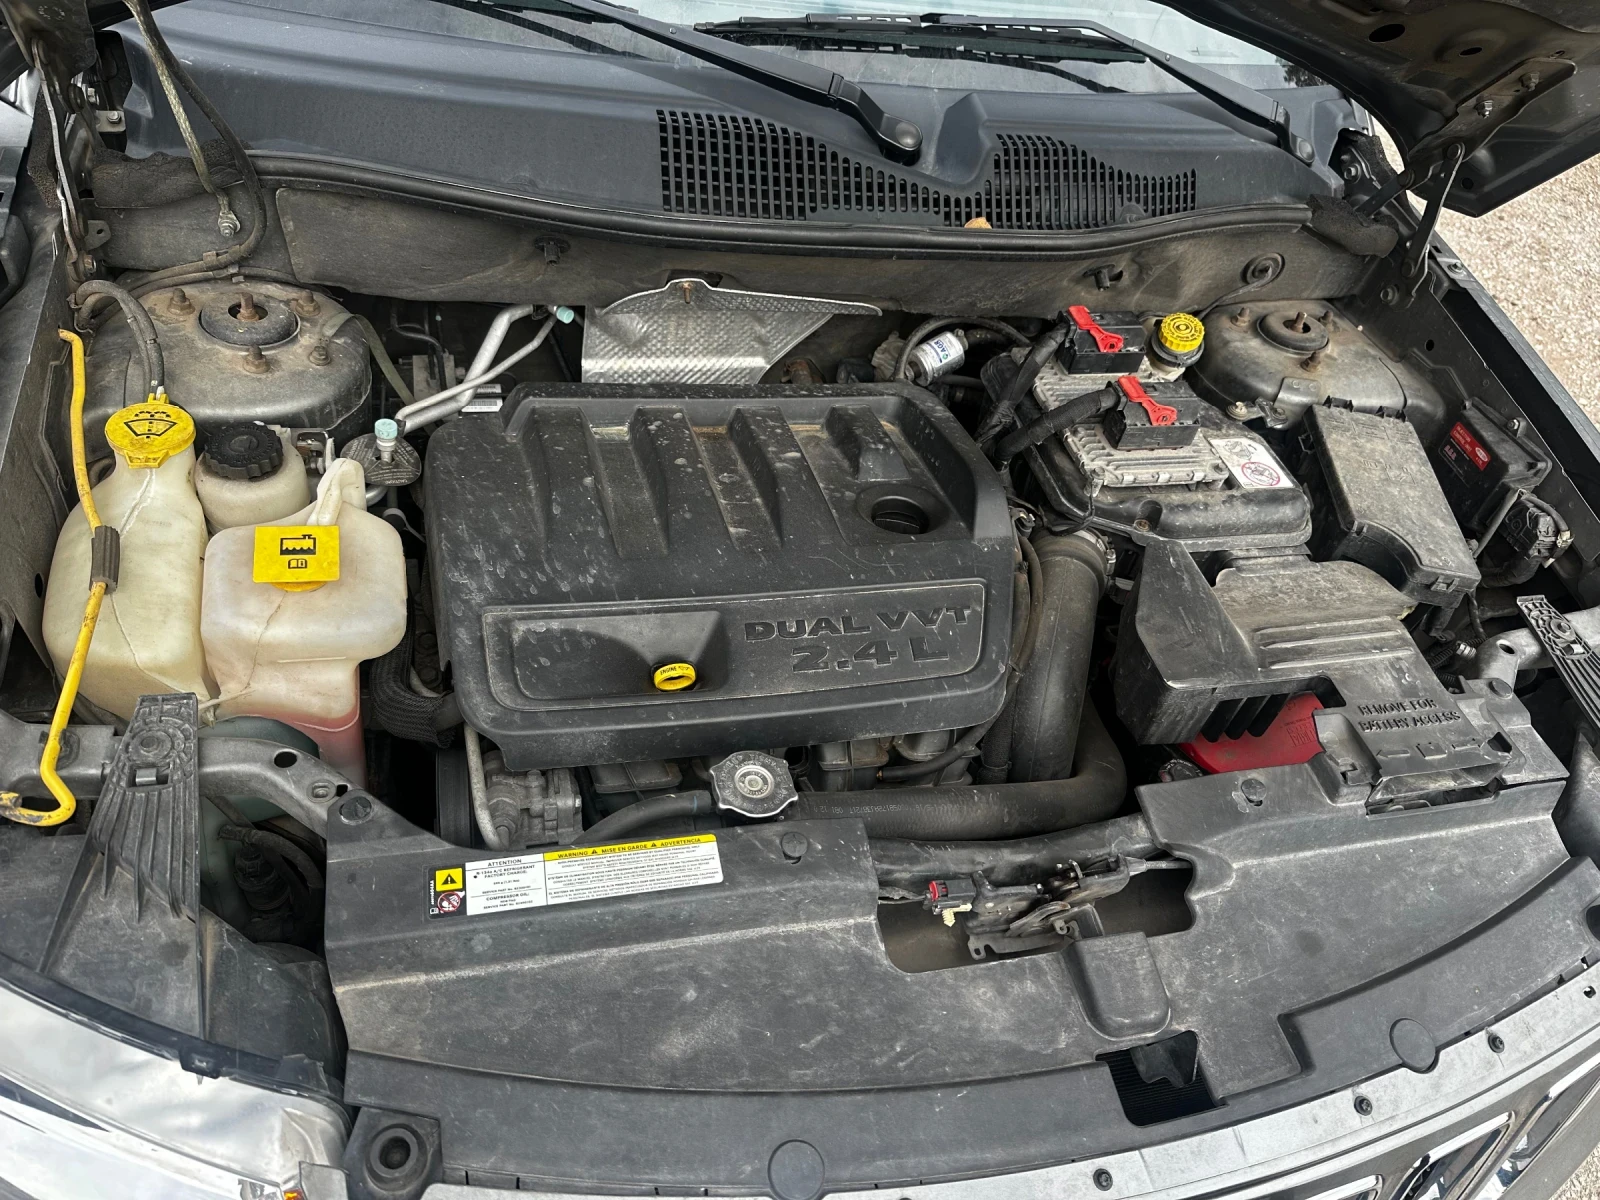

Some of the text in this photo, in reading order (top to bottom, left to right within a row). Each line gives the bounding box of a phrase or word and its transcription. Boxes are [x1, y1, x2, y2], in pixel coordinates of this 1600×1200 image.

[744, 606, 970, 642] DUAL VVT
[792, 637, 949, 672] 2.4 L
[660, 666, 677, 675] ENGINE
[1358, 698, 1438, 716] REMOVE FOR
[1358, 711, 1461, 732] BATTERY ACCESS
[558, 850, 588, 859] WARNING
[661, 838, 701, 847] ADVERTENCIA
